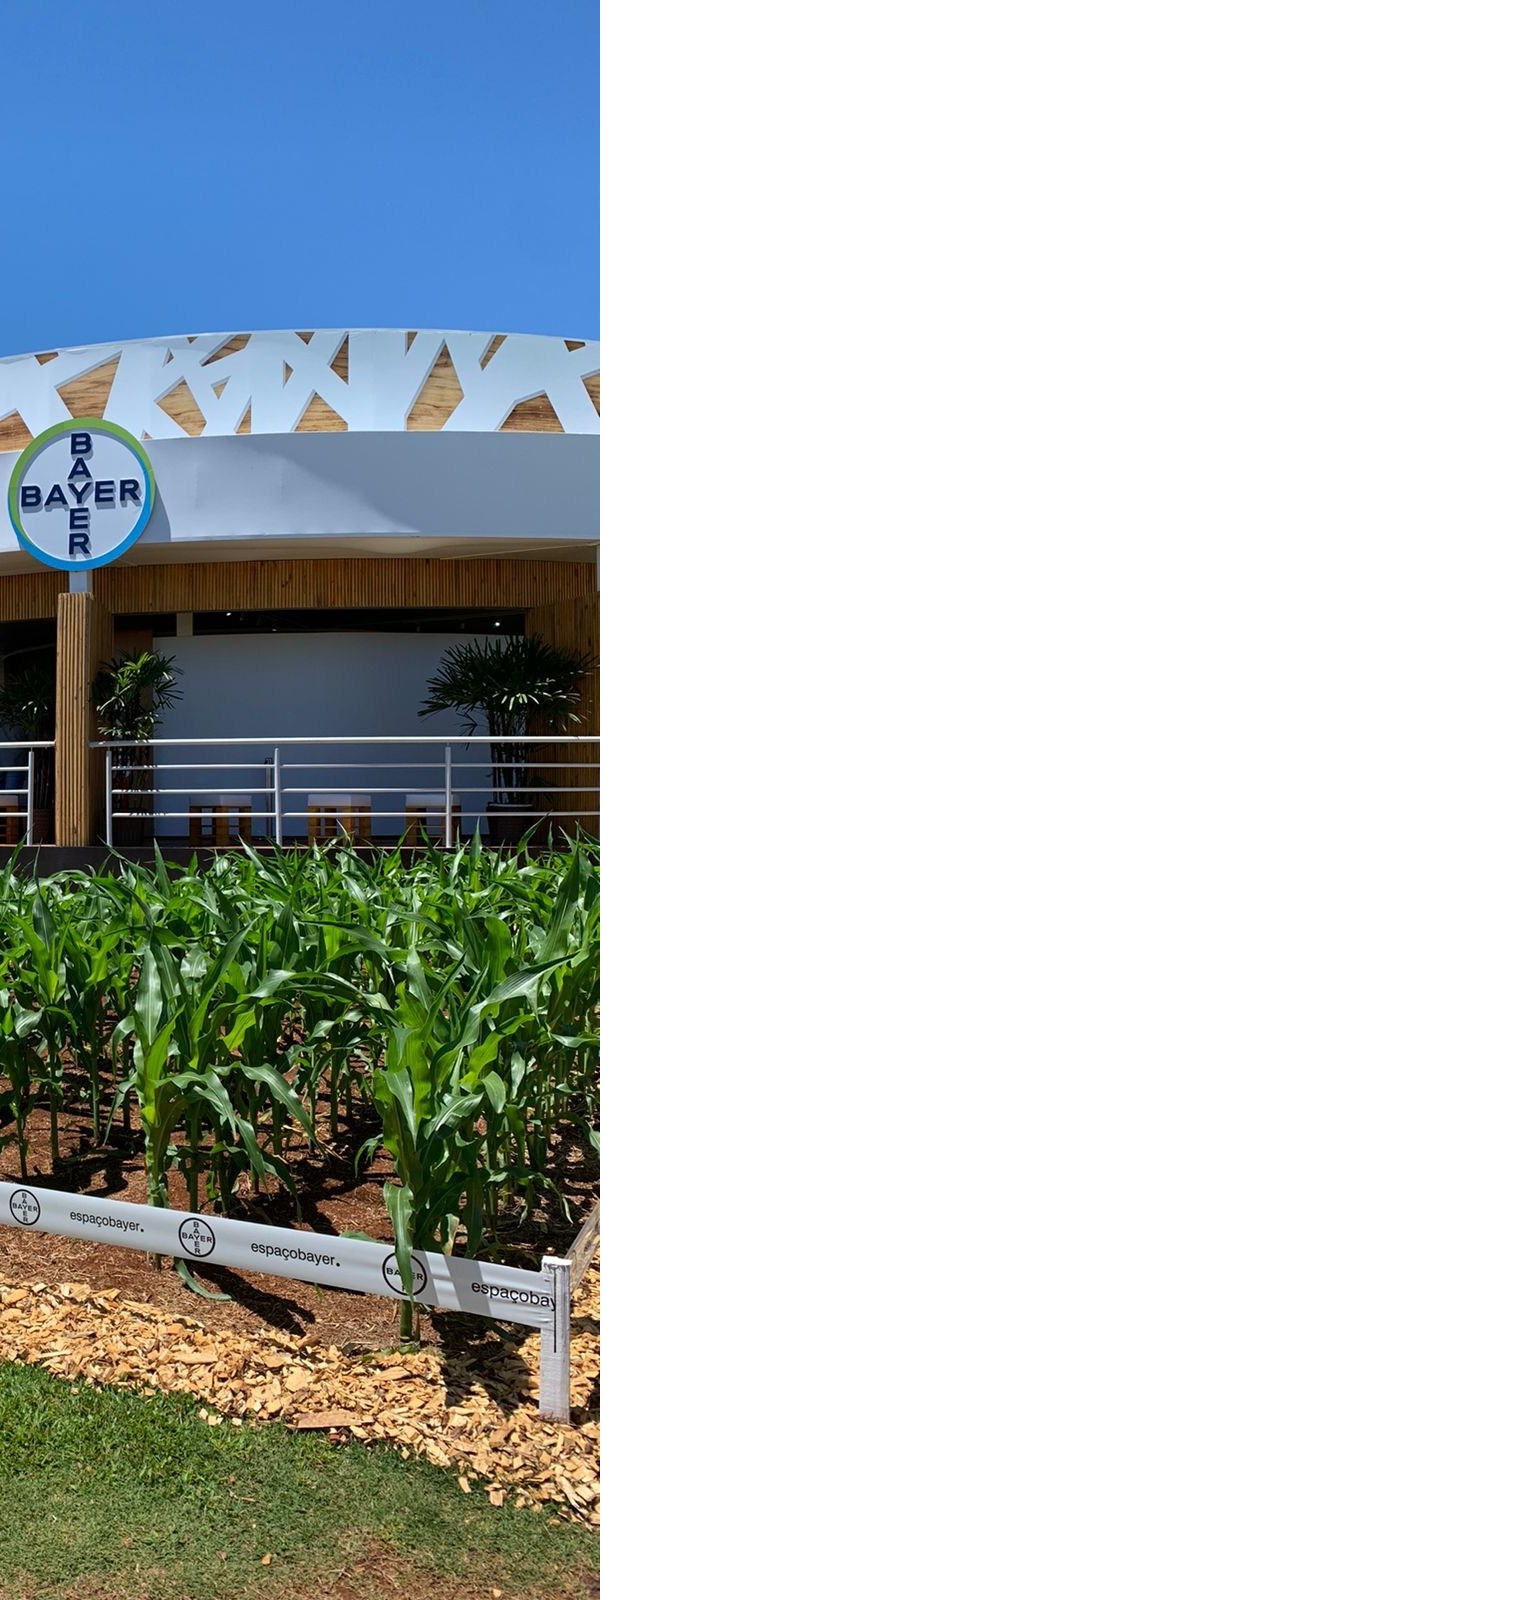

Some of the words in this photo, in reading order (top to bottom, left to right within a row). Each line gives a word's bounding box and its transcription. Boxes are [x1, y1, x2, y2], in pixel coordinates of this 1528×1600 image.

[21, 479, 141, 508] BAYER
[67, 432, 92, 556] BAYER
[12, 1202, 38, 1212] BAYER
[70, 1211, 144, 1233] espaçobayer.
[181, 1231, 212, 1243] BAYER
[250, 1242, 341, 1268] espaçobayer.
[386, 1267, 424, 1281] BAER
